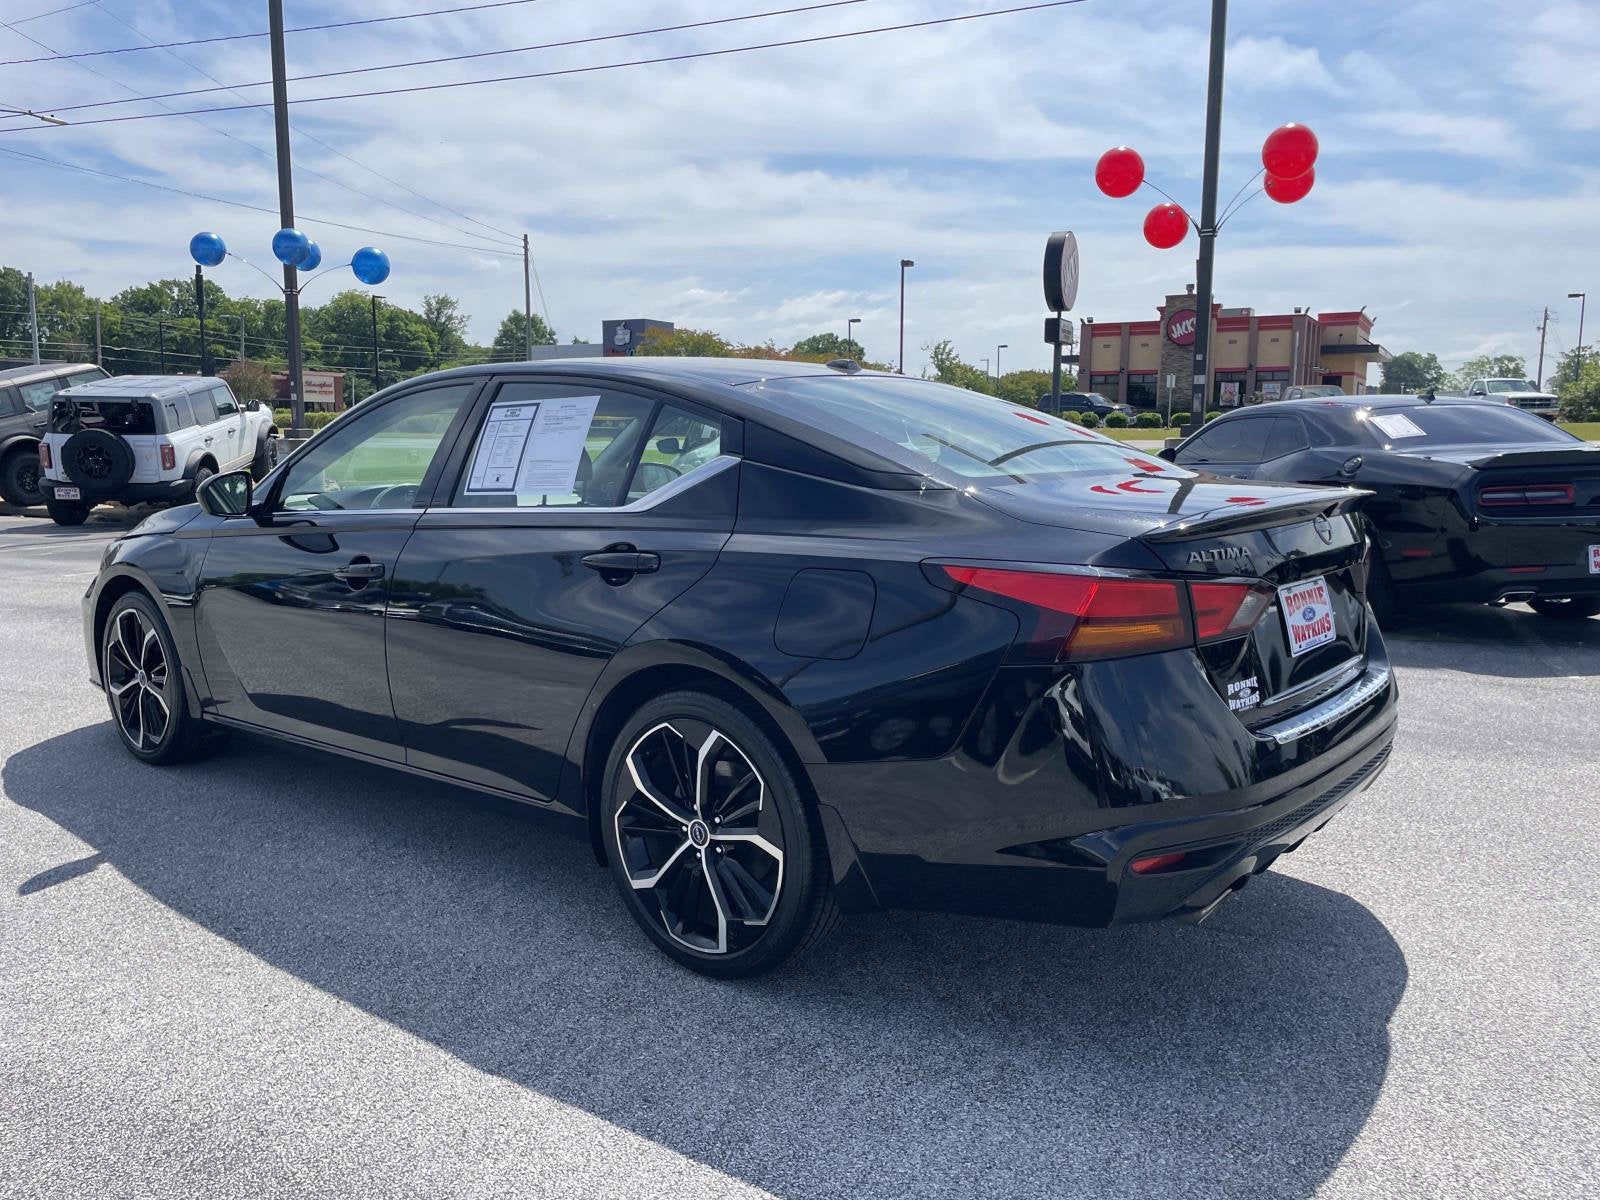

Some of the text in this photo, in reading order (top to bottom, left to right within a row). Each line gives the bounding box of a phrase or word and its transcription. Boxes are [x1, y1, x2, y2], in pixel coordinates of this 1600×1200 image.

[1188, 546, 1252, 564] ALTIMA
[1284, 585, 1328, 617] RONNIE
[1291, 612, 1333, 645] WATKINS
[1227, 676, 1259, 696] RONNIE
[1228, 690, 1260, 711] WATKINS
